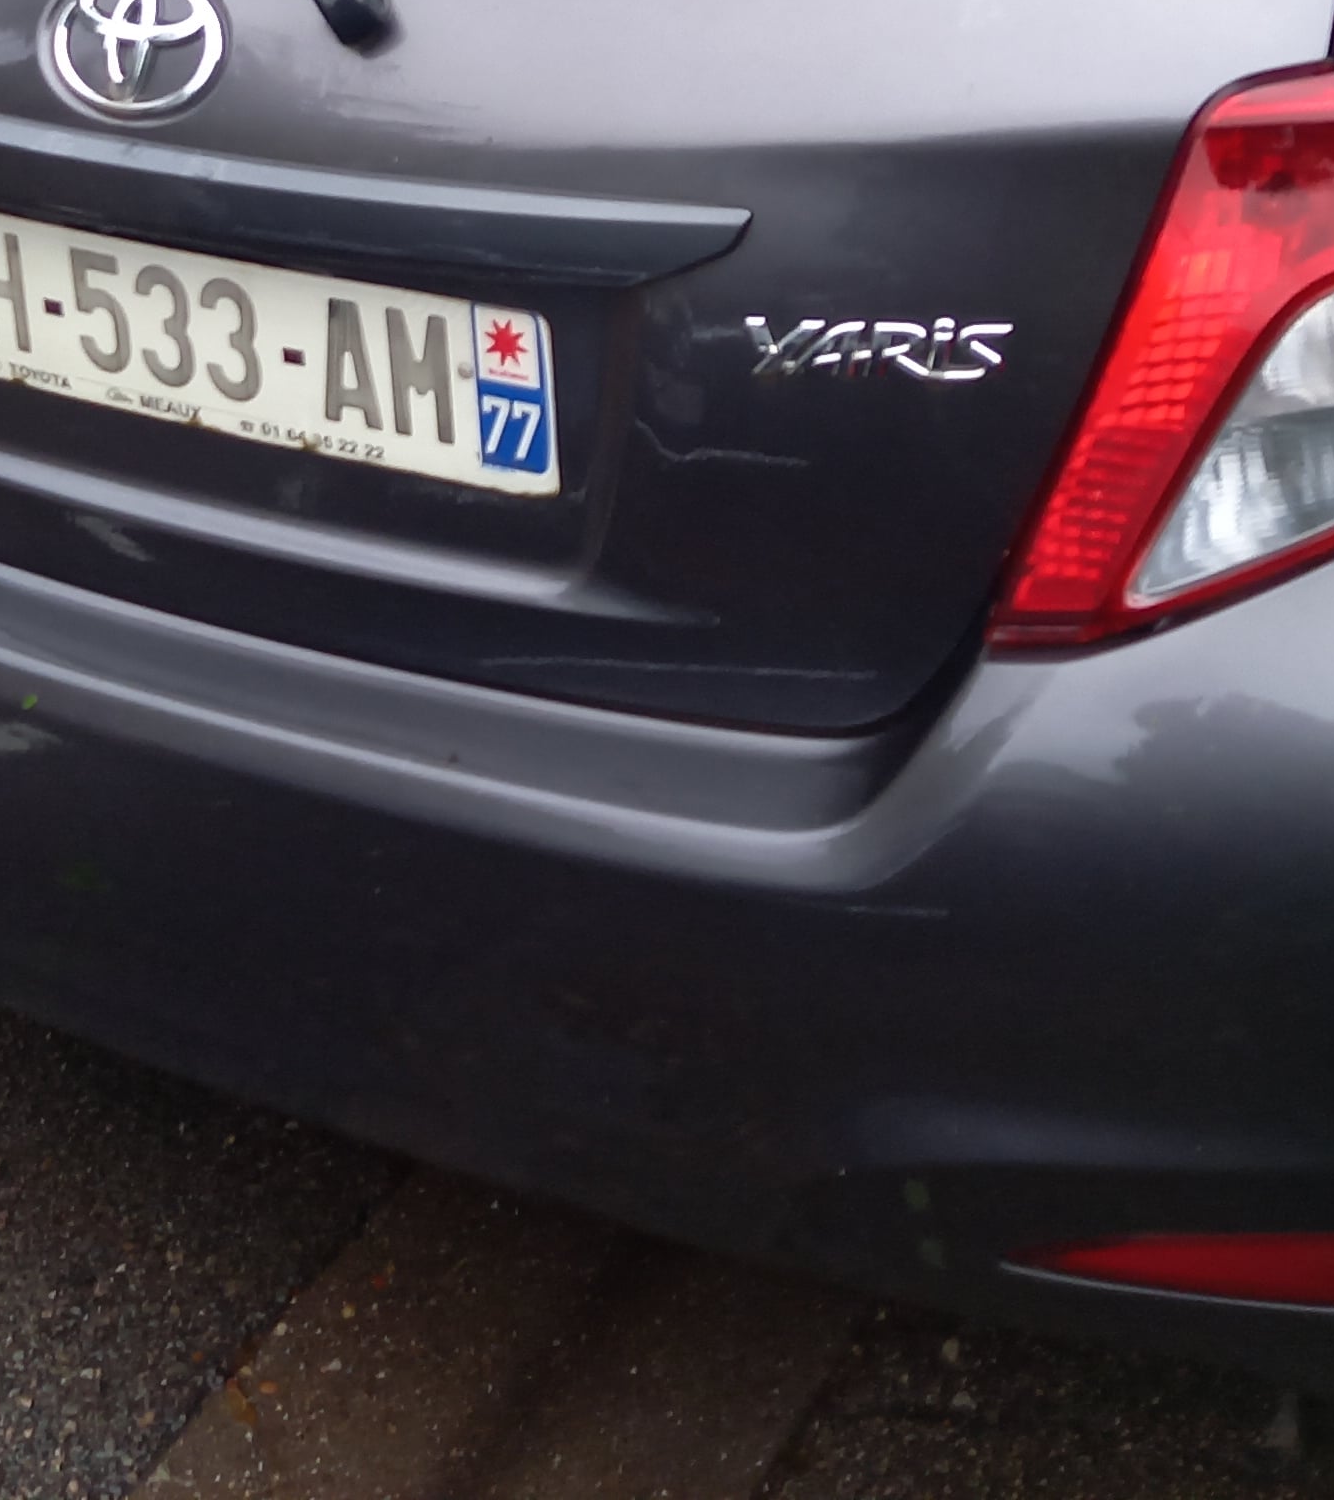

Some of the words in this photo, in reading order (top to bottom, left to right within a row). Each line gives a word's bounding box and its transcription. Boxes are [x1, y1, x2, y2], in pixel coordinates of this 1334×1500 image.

[8, 361, 73, 389] TOYOTA
[140, 394, 203, 419] MEAUX
[481, 393, 542, 462] 77
